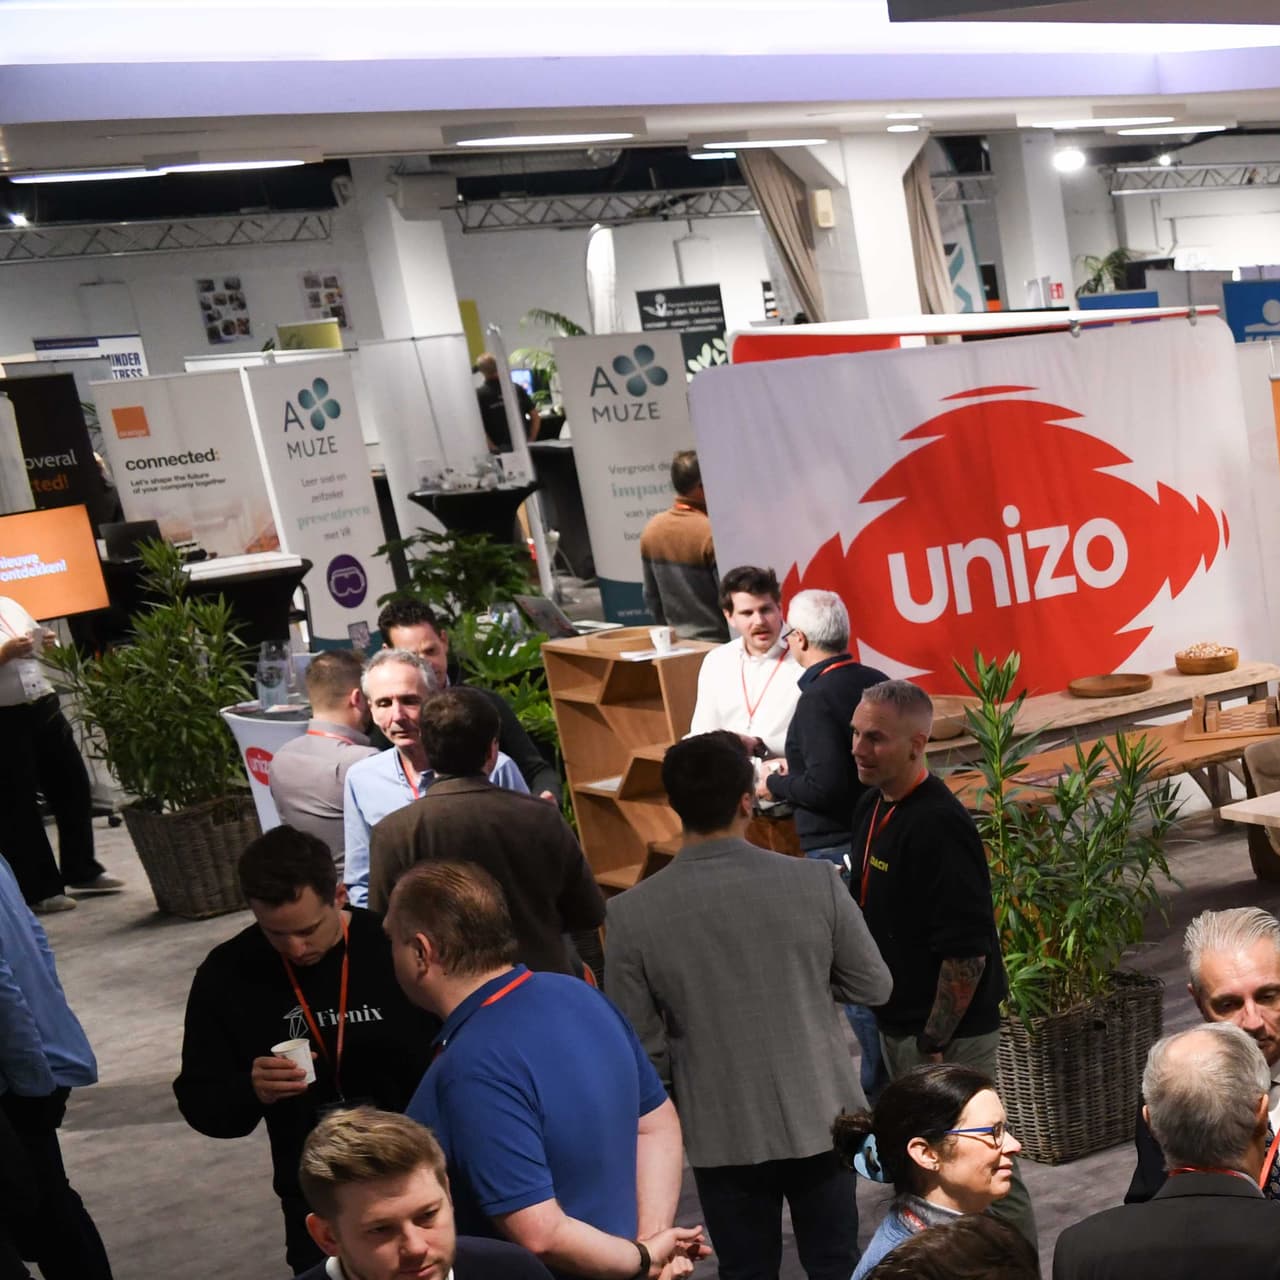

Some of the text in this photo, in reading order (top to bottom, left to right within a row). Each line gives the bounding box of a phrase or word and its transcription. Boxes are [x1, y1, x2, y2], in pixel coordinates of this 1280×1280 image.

[112, 368, 143, 381] TRESS
[589, 366, 618, 397] A
[284, 401, 304, 432] A
[592, 402, 661, 424] MUZE
[287, 436, 338, 460] MUZE
[887, 504, 1129, 624] unizo
